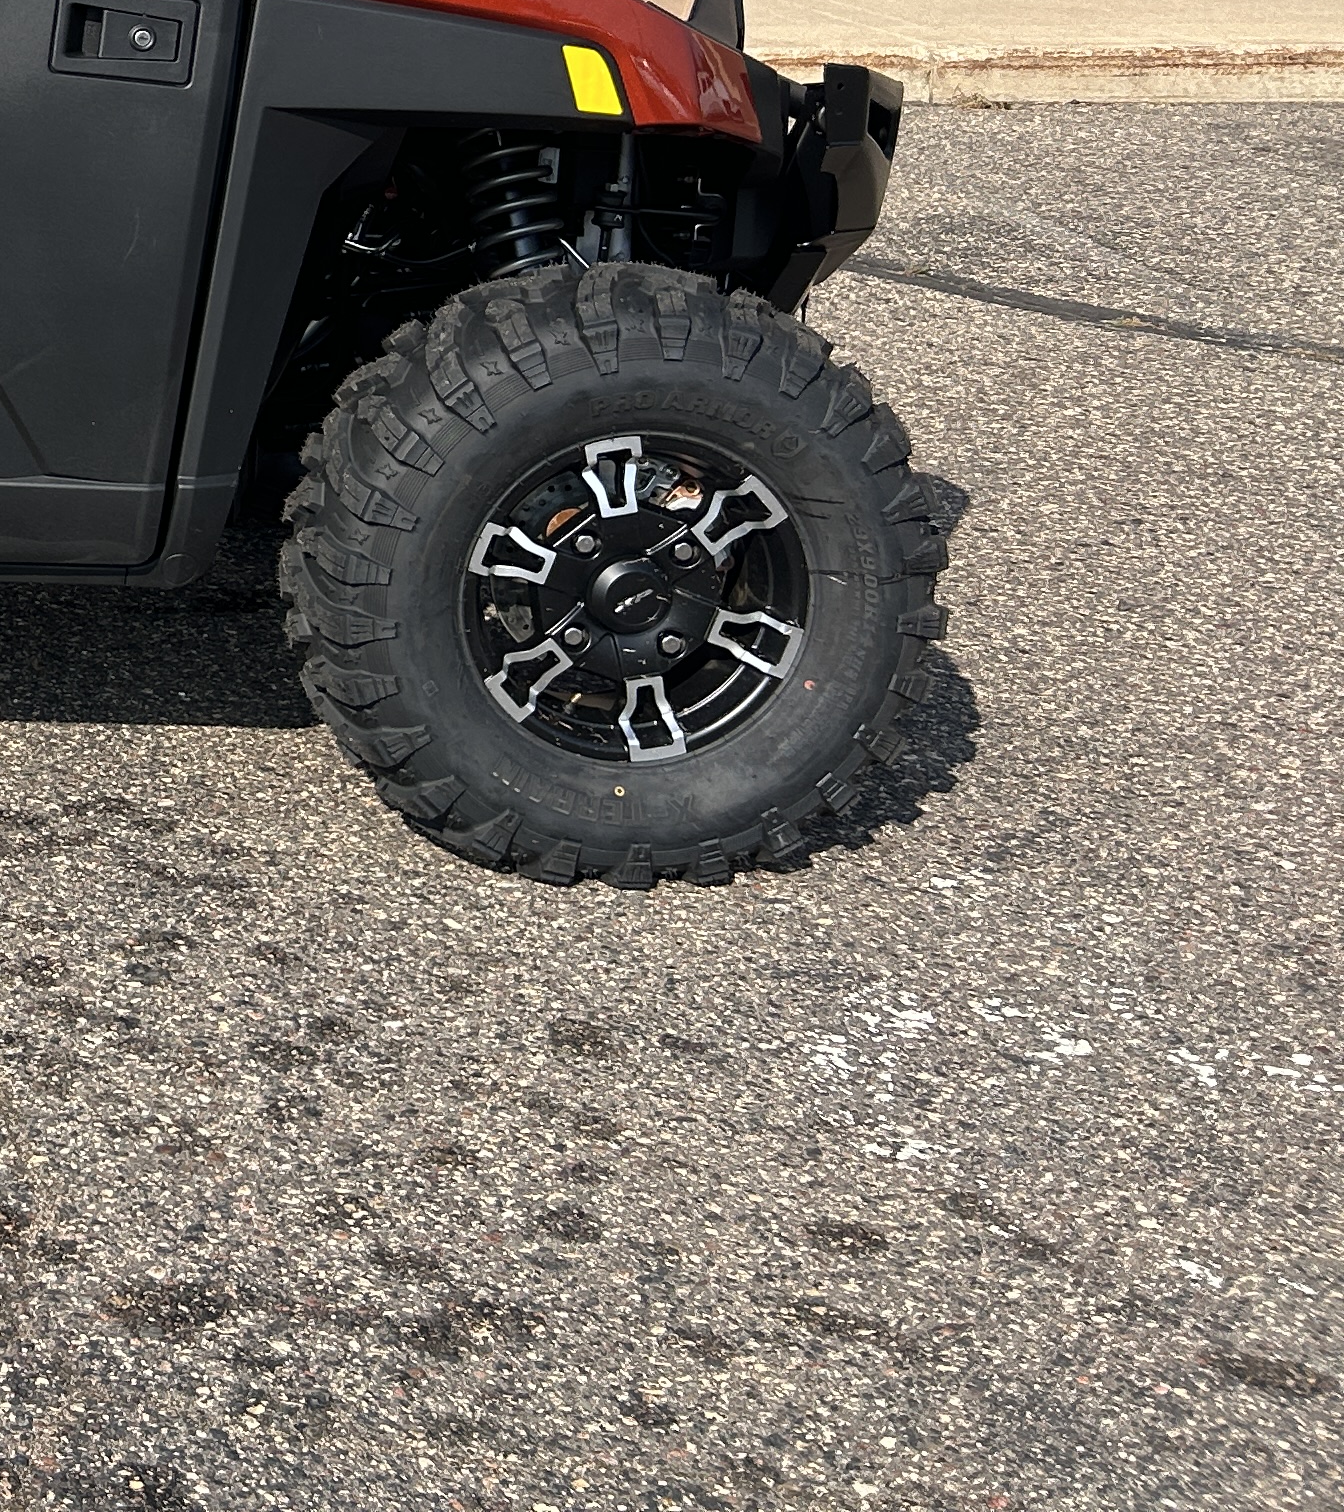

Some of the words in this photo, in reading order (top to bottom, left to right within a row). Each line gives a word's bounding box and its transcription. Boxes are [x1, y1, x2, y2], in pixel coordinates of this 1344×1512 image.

[589, 390, 656, 418] PRO
[661, 389, 777, 440] ARMOR
[491, 751, 701, 832] X-TERRAIN
